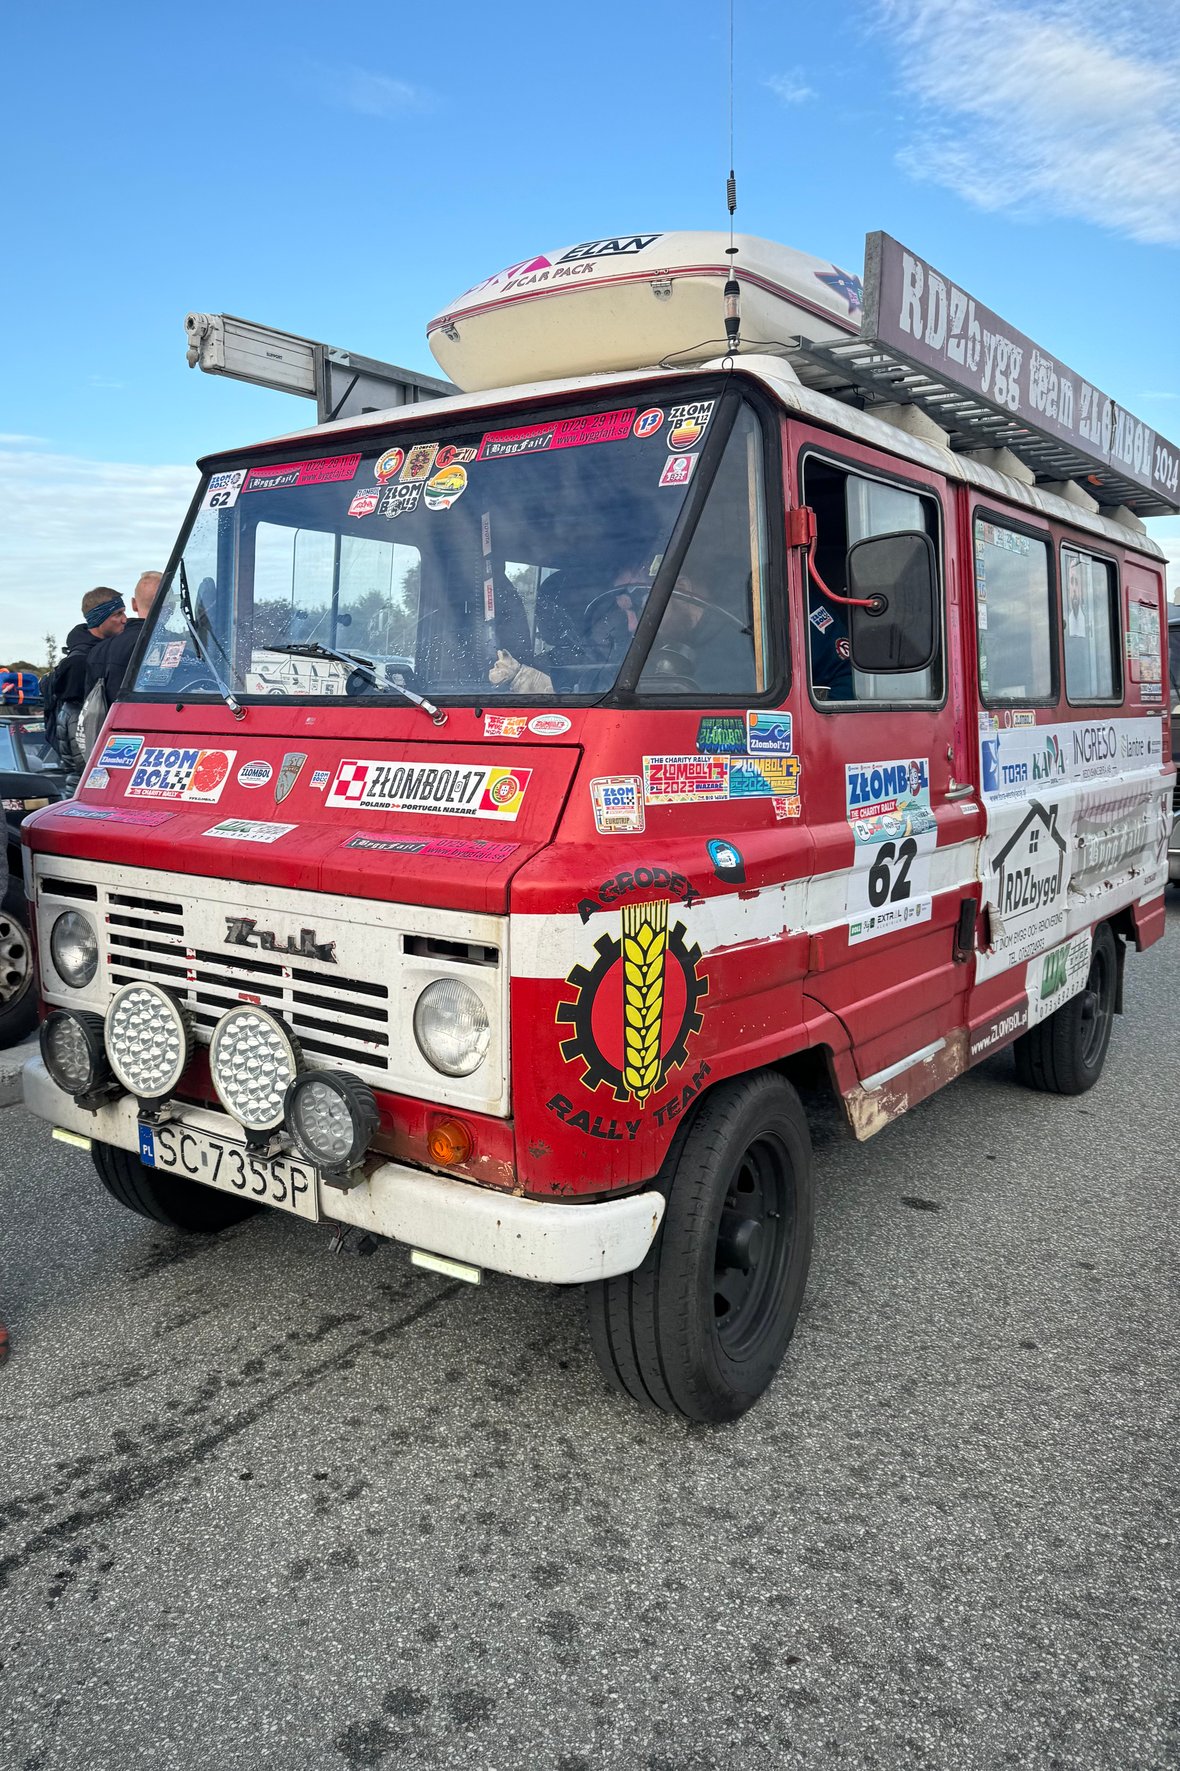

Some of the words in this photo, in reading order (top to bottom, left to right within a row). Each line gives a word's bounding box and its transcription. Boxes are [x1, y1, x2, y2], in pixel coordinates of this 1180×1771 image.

[559, 236, 659, 261] ELAN
[514, 271, 550, 288] CAR
[552, 261, 597, 280] PACK
[899, 250, 1024, 412] RDZbygg
[1028, 349, 1074, 430] team
[1154, 445, 1180, 493] 2024
[561, 415, 605, 433] 0729-29
[640, 413, 660, 431] 13
[556, 426, 629, 445] www.byggfajt.se
[209, 491, 231, 508] 62
[1072, 726, 1117, 765] INGRESO
[140, 748, 200, 769] ZŁOM
[665, 756, 692, 764] CHARITY
[693, 755, 712, 763] RALLY
[602, 786, 635, 797] ZŁOM
[663, 781, 695, 793] 2023
[360, 801, 391, 809] POLAND
[401, 803, 442, 813] PORTUGAL
[442, 806, 478, 815] NAZARÉ
[604, 797, 626, 806] BOL
[860, 805, 881, 818] CHARITY
[881, 801, 896, 813] RALLY
[605, 817, 630, 825] EUROTRIP
[857, 824, 869, 836] PL
[868, 837, 918, 908] 62
[1004, 866, 1058, 914] RDZbygg
[545, 1092, 642, 1141] RALLY
[652, 1059, 712, 1128] TEAM
[142, 1144, 153, 1158] PL
[157, 1126, 200, 1175] SC
[208, 1141, 309, 1209] 7355P
